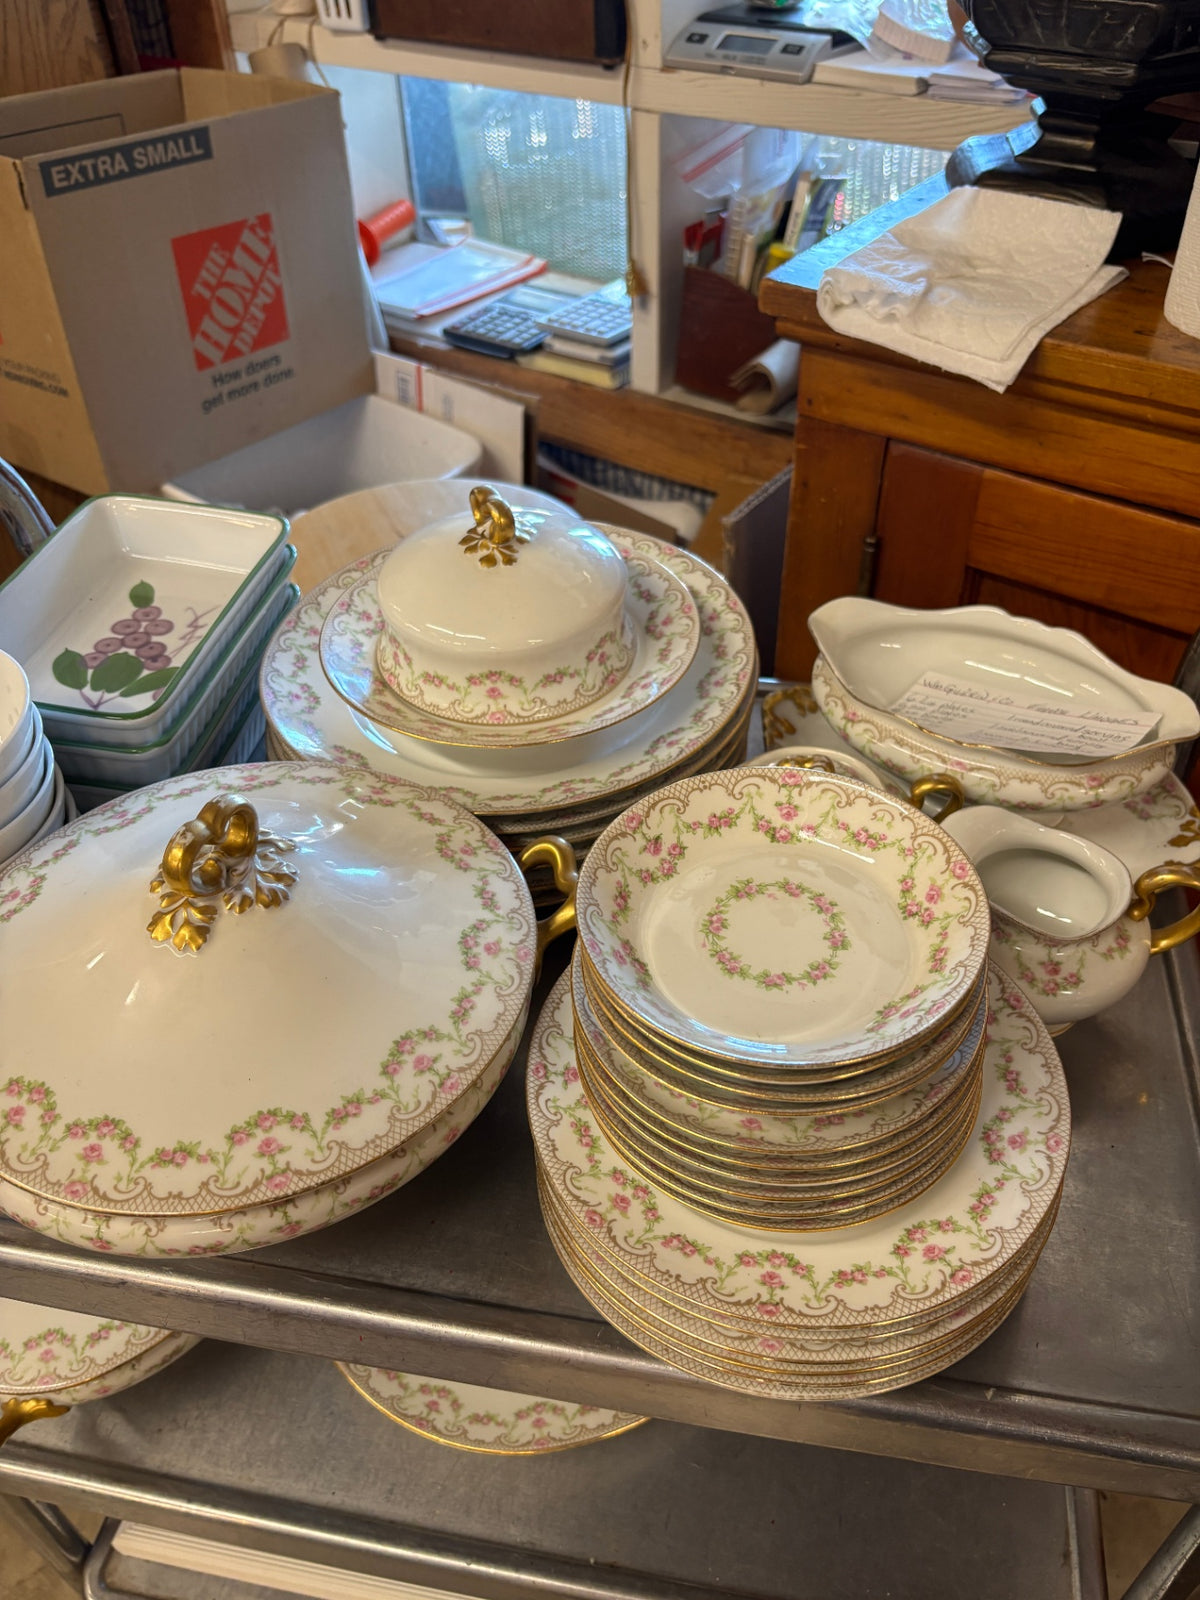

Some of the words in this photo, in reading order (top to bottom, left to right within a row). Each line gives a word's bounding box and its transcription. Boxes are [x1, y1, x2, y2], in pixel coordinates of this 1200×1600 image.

[50, 153, 129, 189] EXTRA
[134, 134, 206, 169] SMALL
[191, 242, 234, 298] THE
[192, 215, 276, 366] HOME
[231, 262, 284, 355] DEPOT
[202, 391, 224, 415] get
[226, 381, 260, 400] more
[211, 368, 242, 388] How
[245, 354, 282, 376] doers
